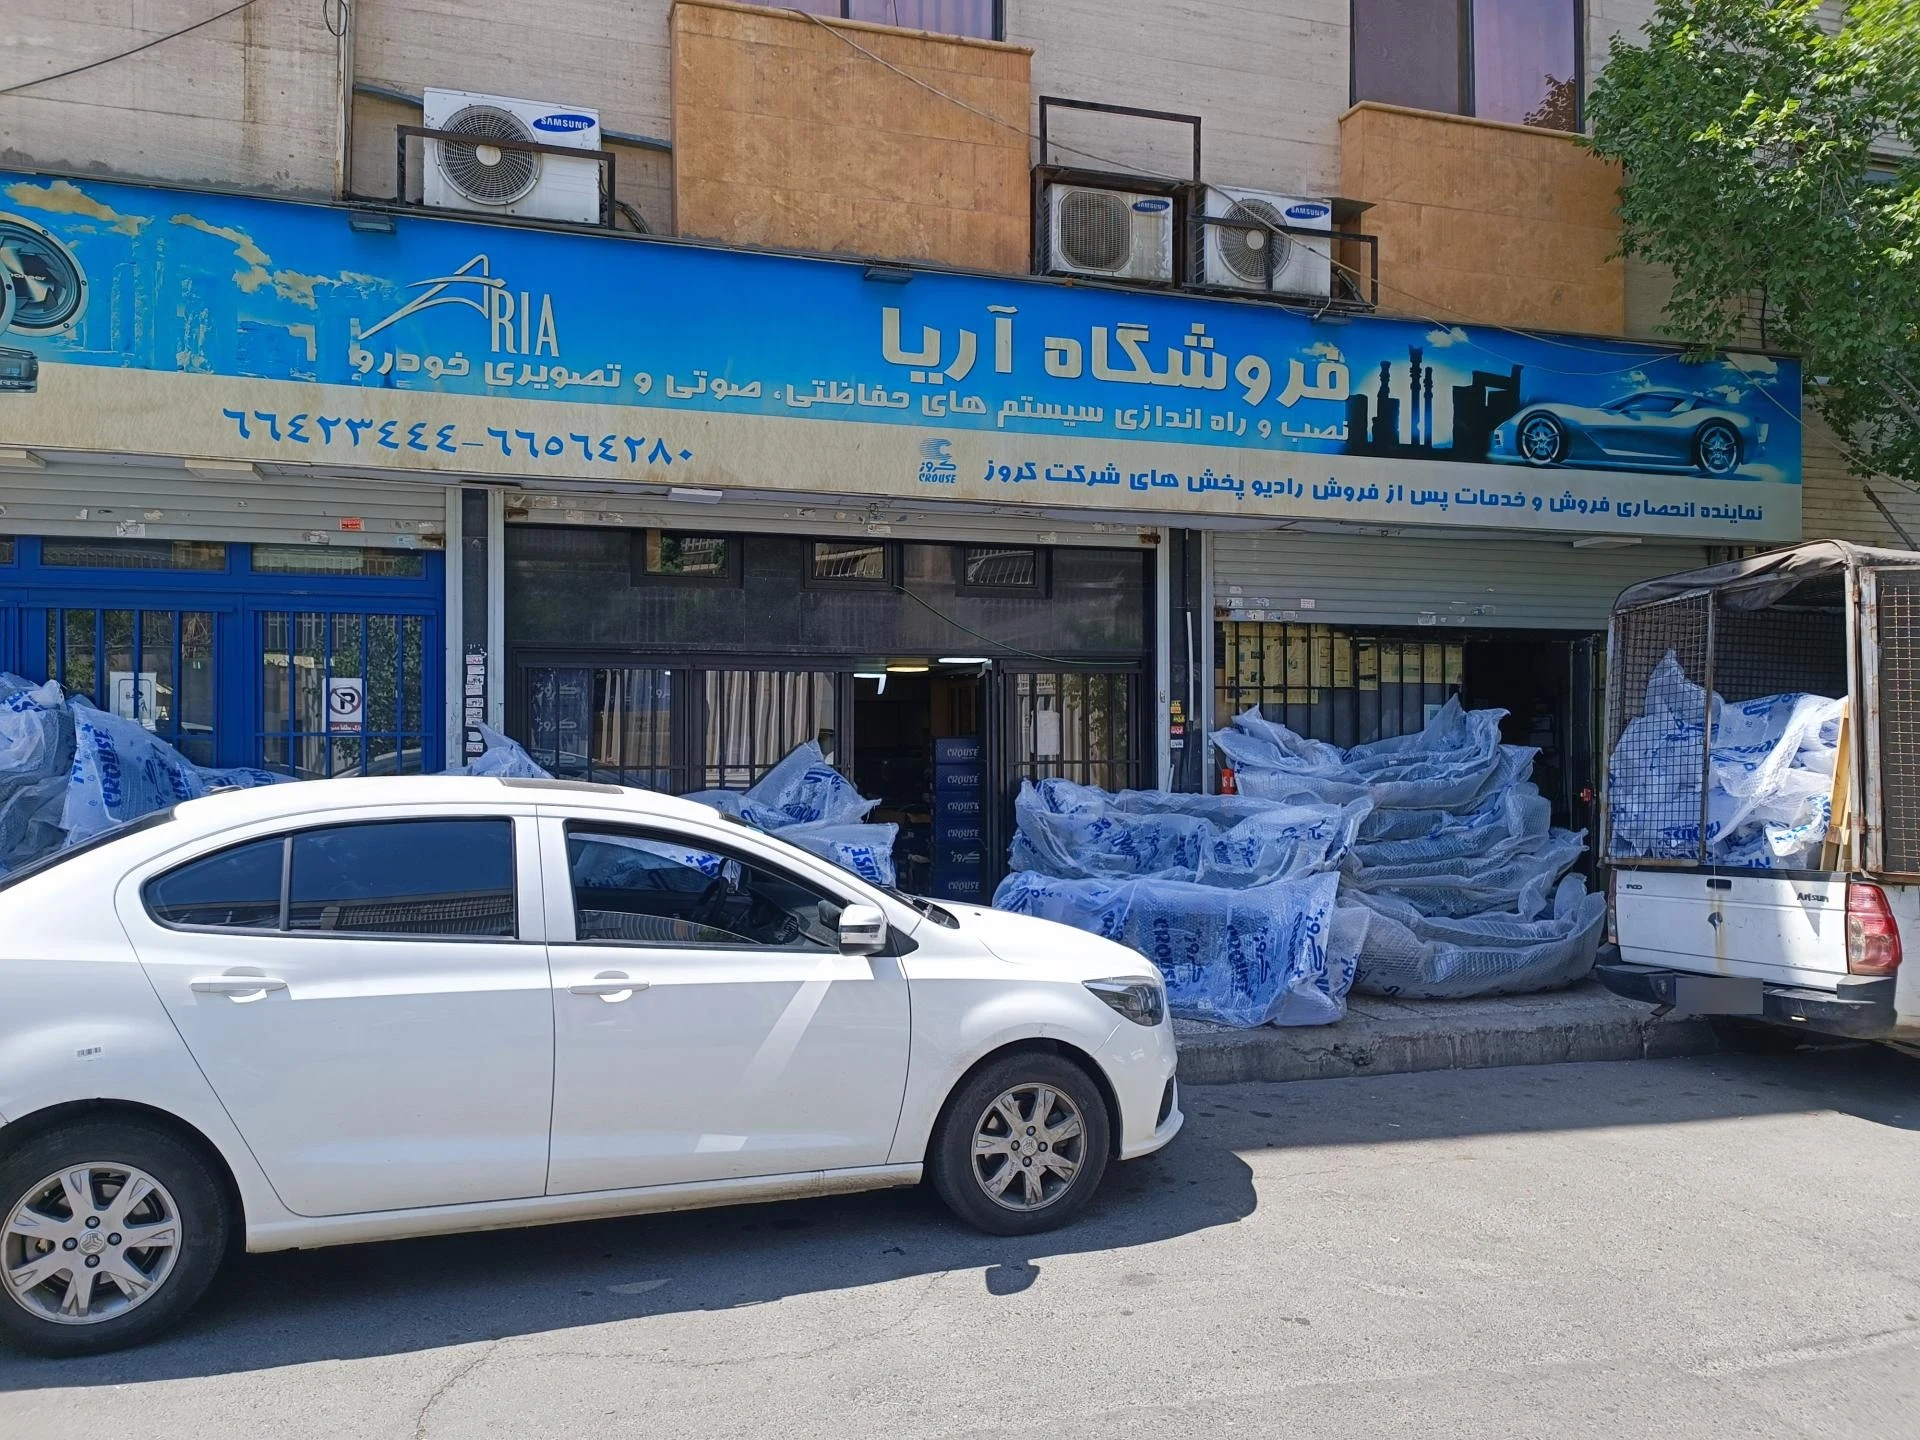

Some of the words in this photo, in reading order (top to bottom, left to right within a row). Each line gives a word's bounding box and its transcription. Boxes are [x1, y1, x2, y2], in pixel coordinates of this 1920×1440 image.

[541, 117, 589, 129] SAMSUNG
[1136, 202, 1166, 211] SAMSUNG
[1290, 206, 1325, 218] SAMSUNG
[358, 254, 561, 358] ARIA
[881, 304, 1018, 385] آریا
[354, 350, 470, 382] خودرو
[484, 361, 622, 391] تصویری
[1044, 321, 1350, 408] فروشگاه
[633, 371, 652, 396] و
[665, 370, 762, 401] صوتی
[921, 390, 987, 417] های
[997, 395, 1103, 428] سیستم
[1115, 404, 1201, 430] اندازی
[1210, 411, 1247, 436] راه
[1257, 419, 1272, 439] و
[1281, 419, 1350, 443] نصب
[918, 472, 957, 484] CROUSE
[983, 459, 1037, 482] کروز
[1045, 462, 1121, 487] شرکت
[1129, 467, 1179, 491] های
[1187, 469, 1245, 500] پخش
[1251, 477, 1303, 499] رادیو
[1312, 477, 1379, 502] فروش
[1385, 480, 1403, 505] از
[1410, 488, 1448, 511] پس
[1455, 487, 1526, 507] خدمات
[1532, 496, 1543, 512] و
[1550, 490, 1610, 514] فروش
[1616, 499, 1694, 518] انحصاری
[1700, 503, 1763, 524] نماینده
